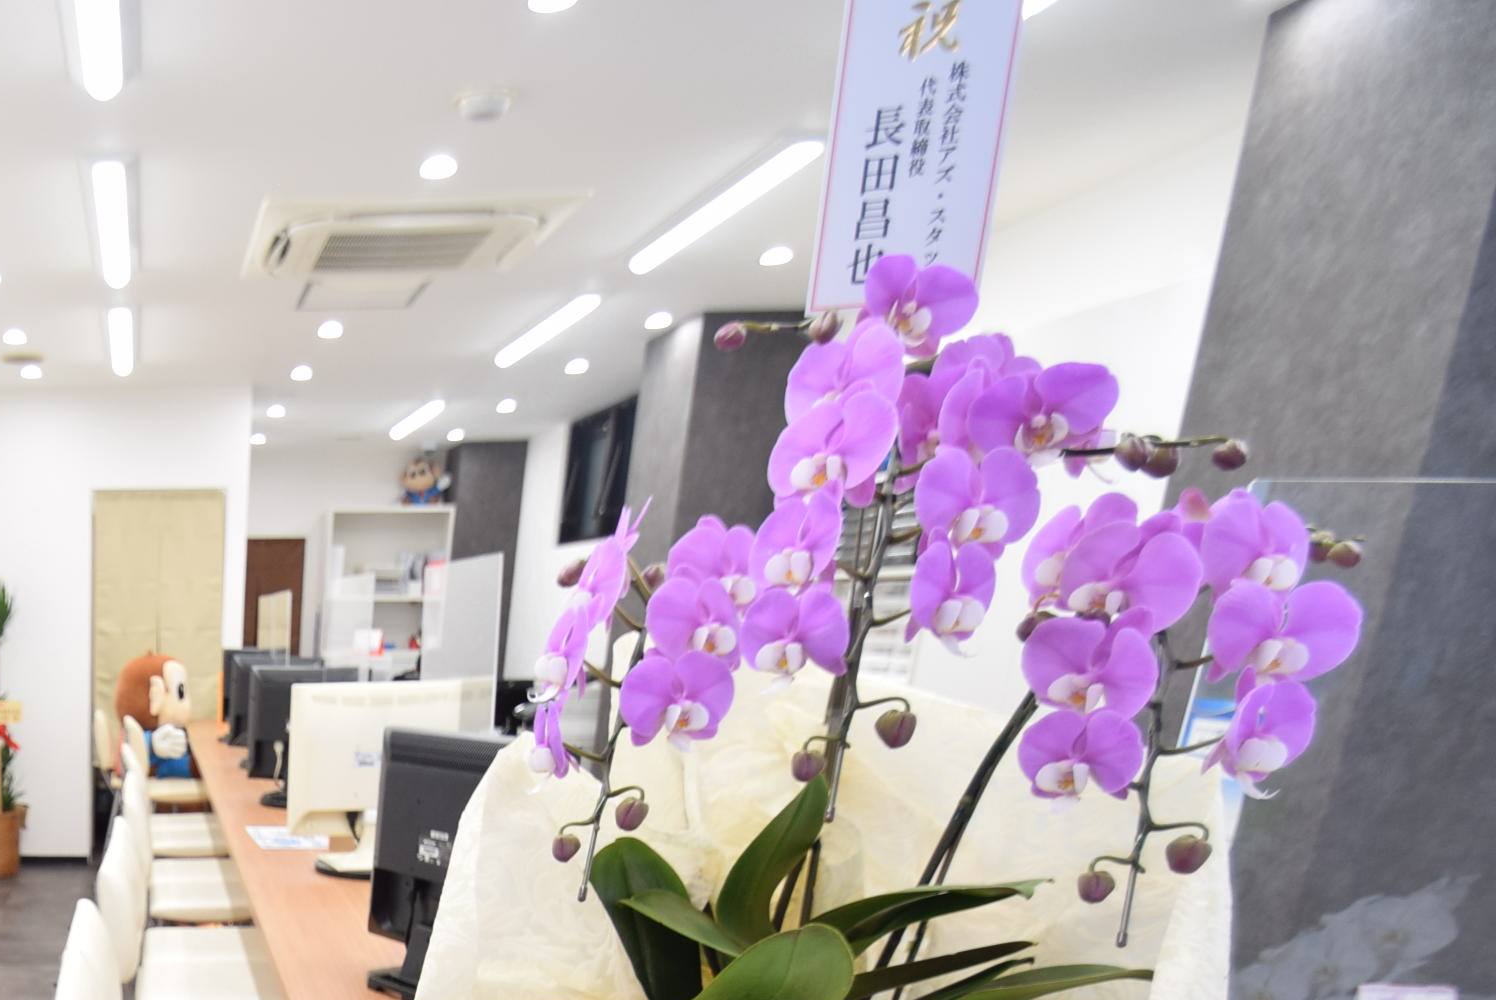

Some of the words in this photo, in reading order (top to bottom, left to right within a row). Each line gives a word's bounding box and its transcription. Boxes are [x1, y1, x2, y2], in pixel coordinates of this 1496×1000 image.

[898, 1, 960, 62] 祝
[908, 77, 938, 178] 代表取締役
